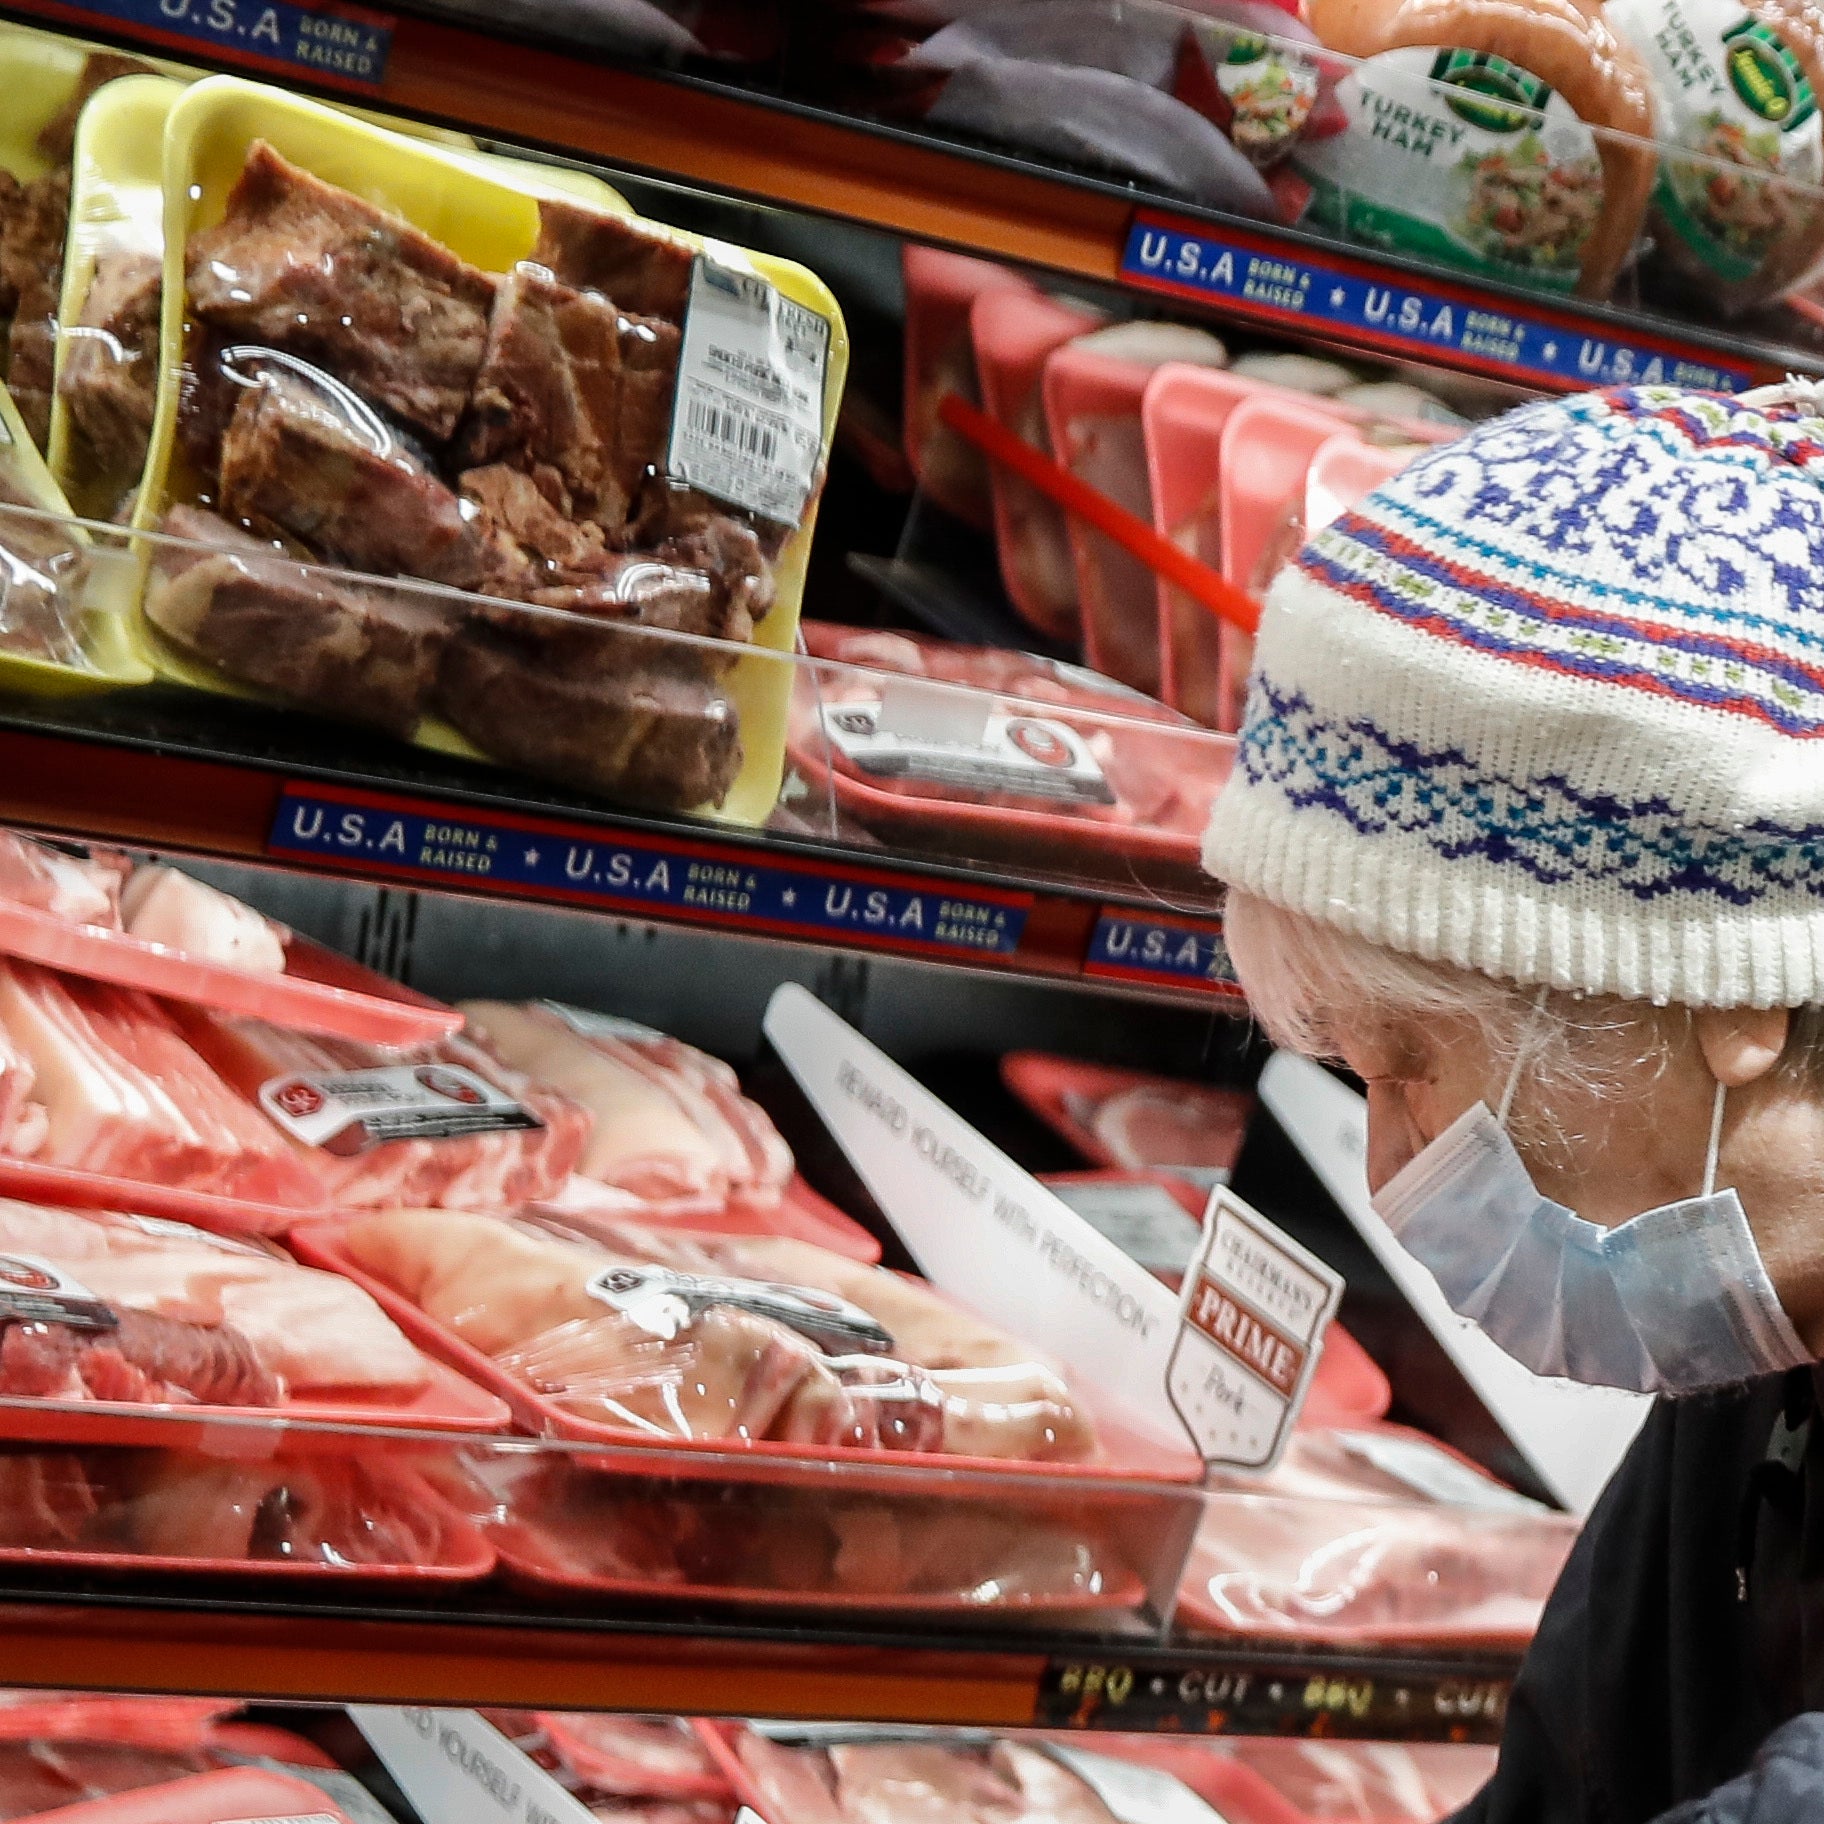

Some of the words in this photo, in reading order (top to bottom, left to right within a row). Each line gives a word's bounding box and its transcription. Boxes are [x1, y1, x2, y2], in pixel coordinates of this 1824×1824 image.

[300, 14, 358, 46] BORN
[296, 39, 373, 76] RAISED
[1359, 86, 1466, 145] TURKEY
[1372, 117, 1434, 158] HAM
[1139, 231, 1235, 286] U.S.A
[1248, 256, 1298, 289] BORN
[1242, 278, 1306, 311] RAISED
[1363, 287, 1455, 339] U.S.A
[1577, 338, 1665, 386] U.S.A
[293, 805, 406, 854] U.S.A
[425, 823, 480, 849] BORN
[420, 845, 492, 873] RAISED
[565, 847, 671, 892] U.S.A
[687, 862, 740, 888] BORN
[683, 884, 751, 911] RAISED
[825, 885, 925, 930] U.S.A
[939, 901, 991, 926] BORN
[934, 922, 999, 949] RAISED
[1106, 924, 1199, 969] U.S.A
[909, 1120, 992, 1201] YOURSELF
[992, 1190, 1039, 1244] WITH
[1199, 1284, 1297, 1381] PRIME
[1203, 1363, 1245, 1417] Pork
[1058, 1663, 1134, 1706] BBQ
[1177, 1669, 1252, 1703] CUT
[437, 1720, 523, 1813] YOURSELF
